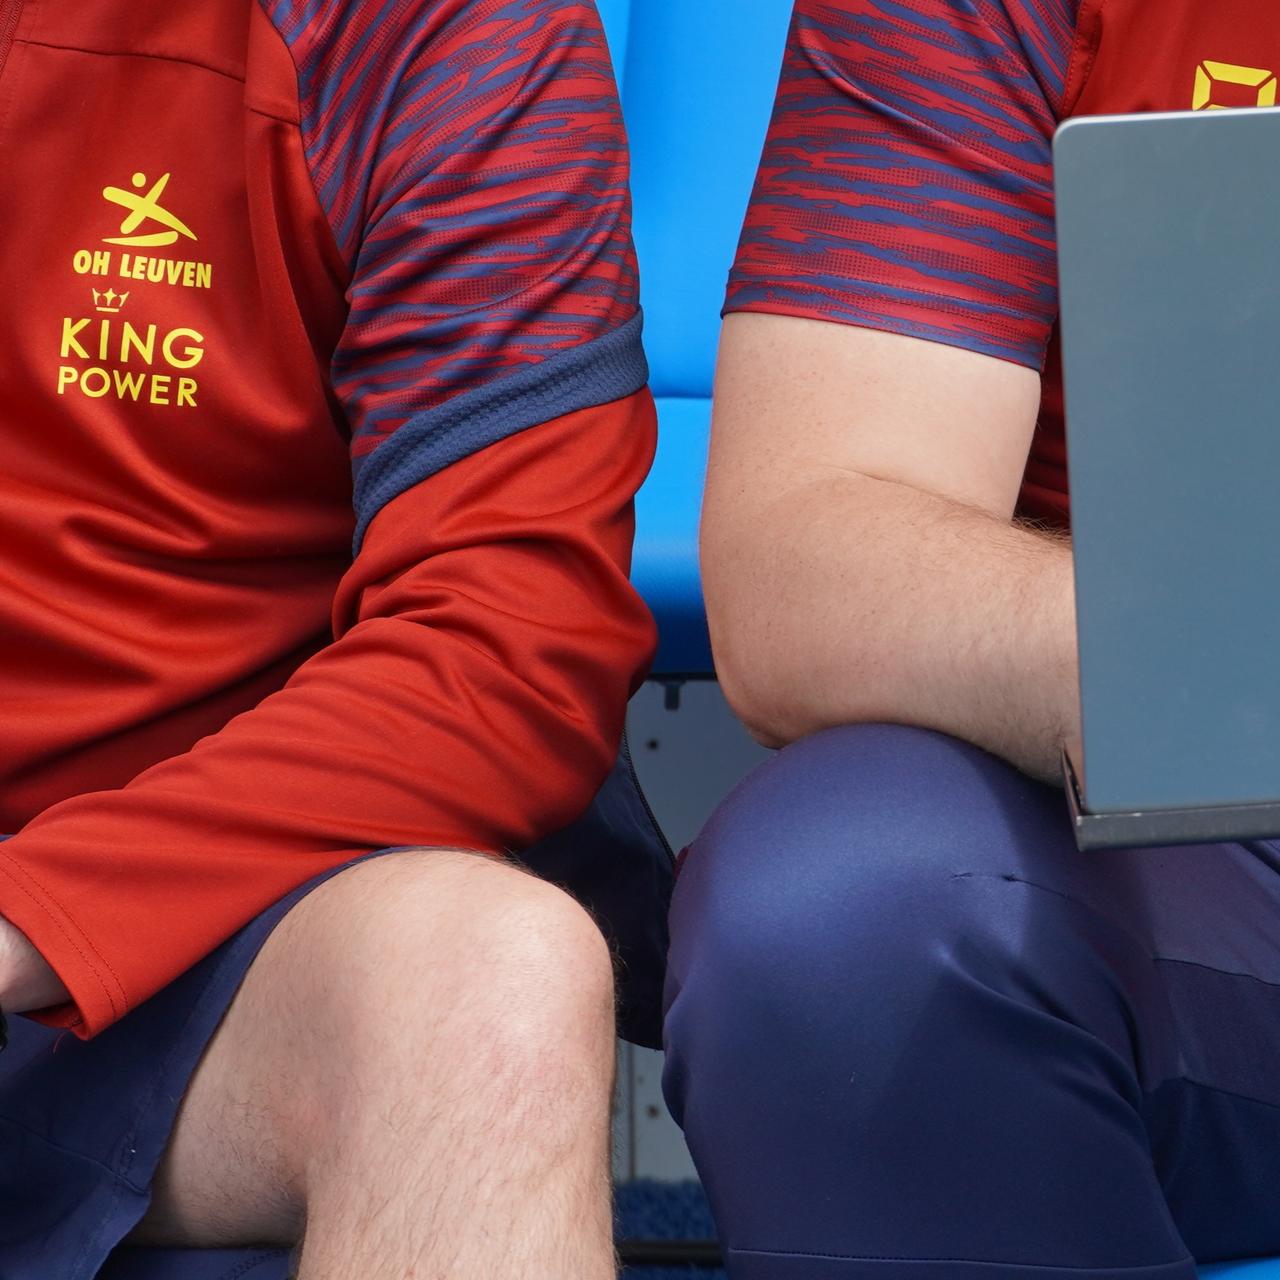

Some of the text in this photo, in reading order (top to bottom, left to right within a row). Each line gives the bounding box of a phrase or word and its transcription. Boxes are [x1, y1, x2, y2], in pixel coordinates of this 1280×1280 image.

[72, 249, 213, 289] OH LEUVEN
[60, 317, 205, 369] KING
[57, 365, 198, 407] POWER
